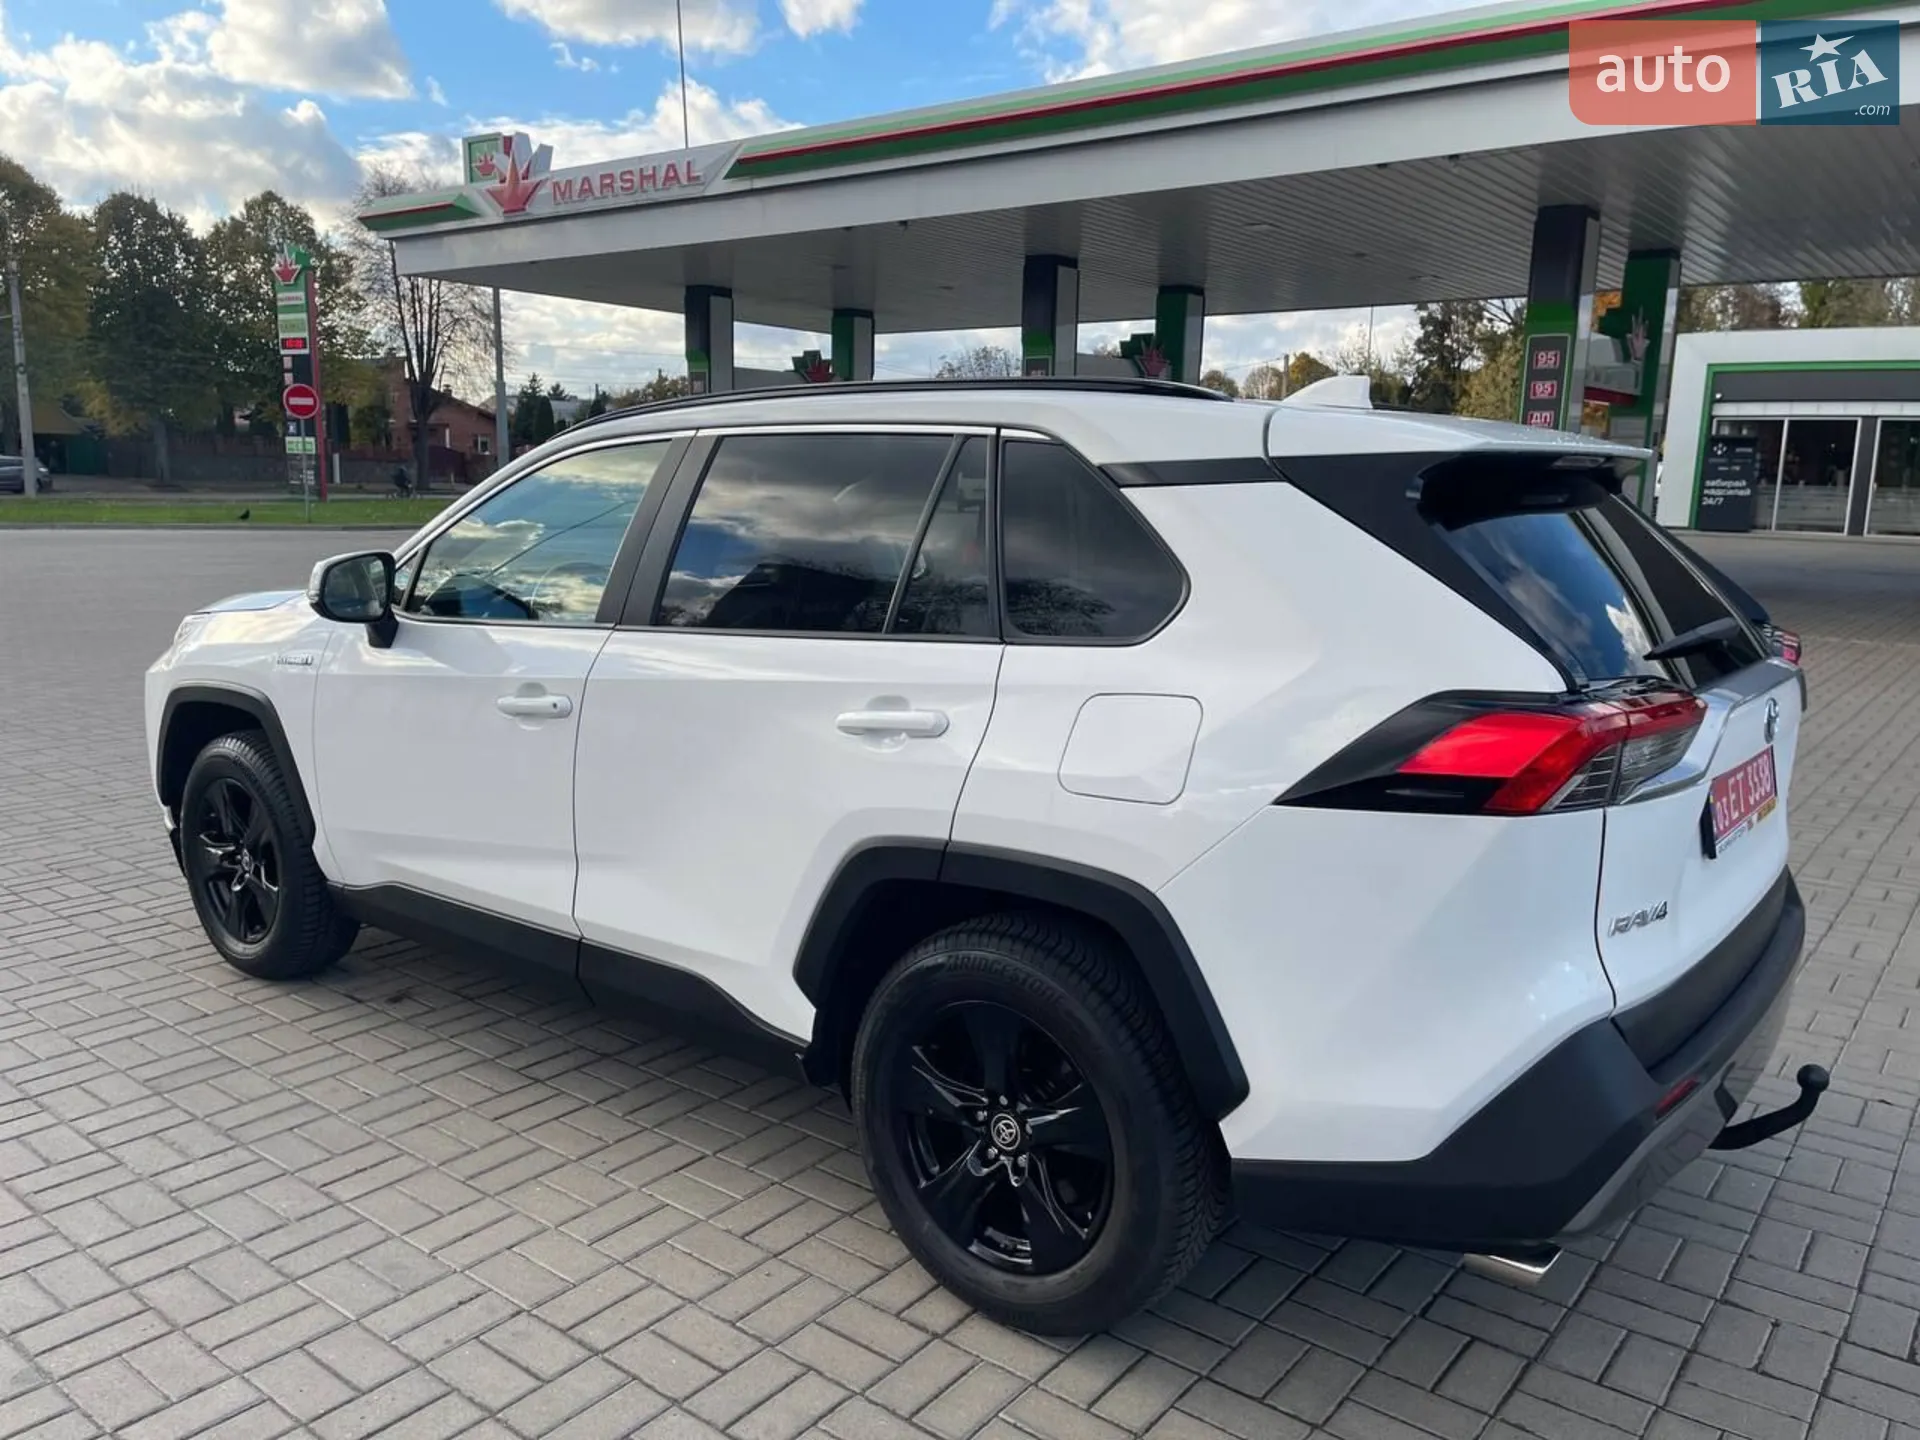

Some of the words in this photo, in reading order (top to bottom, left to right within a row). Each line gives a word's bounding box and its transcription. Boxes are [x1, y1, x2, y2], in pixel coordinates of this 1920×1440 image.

[552, 160, 704, 205] MARSHAL
[1537, 351, 1555, 364] 95
[1535, 383, 1552, 395] 95
[1702, 497, 1724, 505] 24/7
[1728, 771, 1745, 820] ET
[1608, 900, 1668, 938] RAV4
